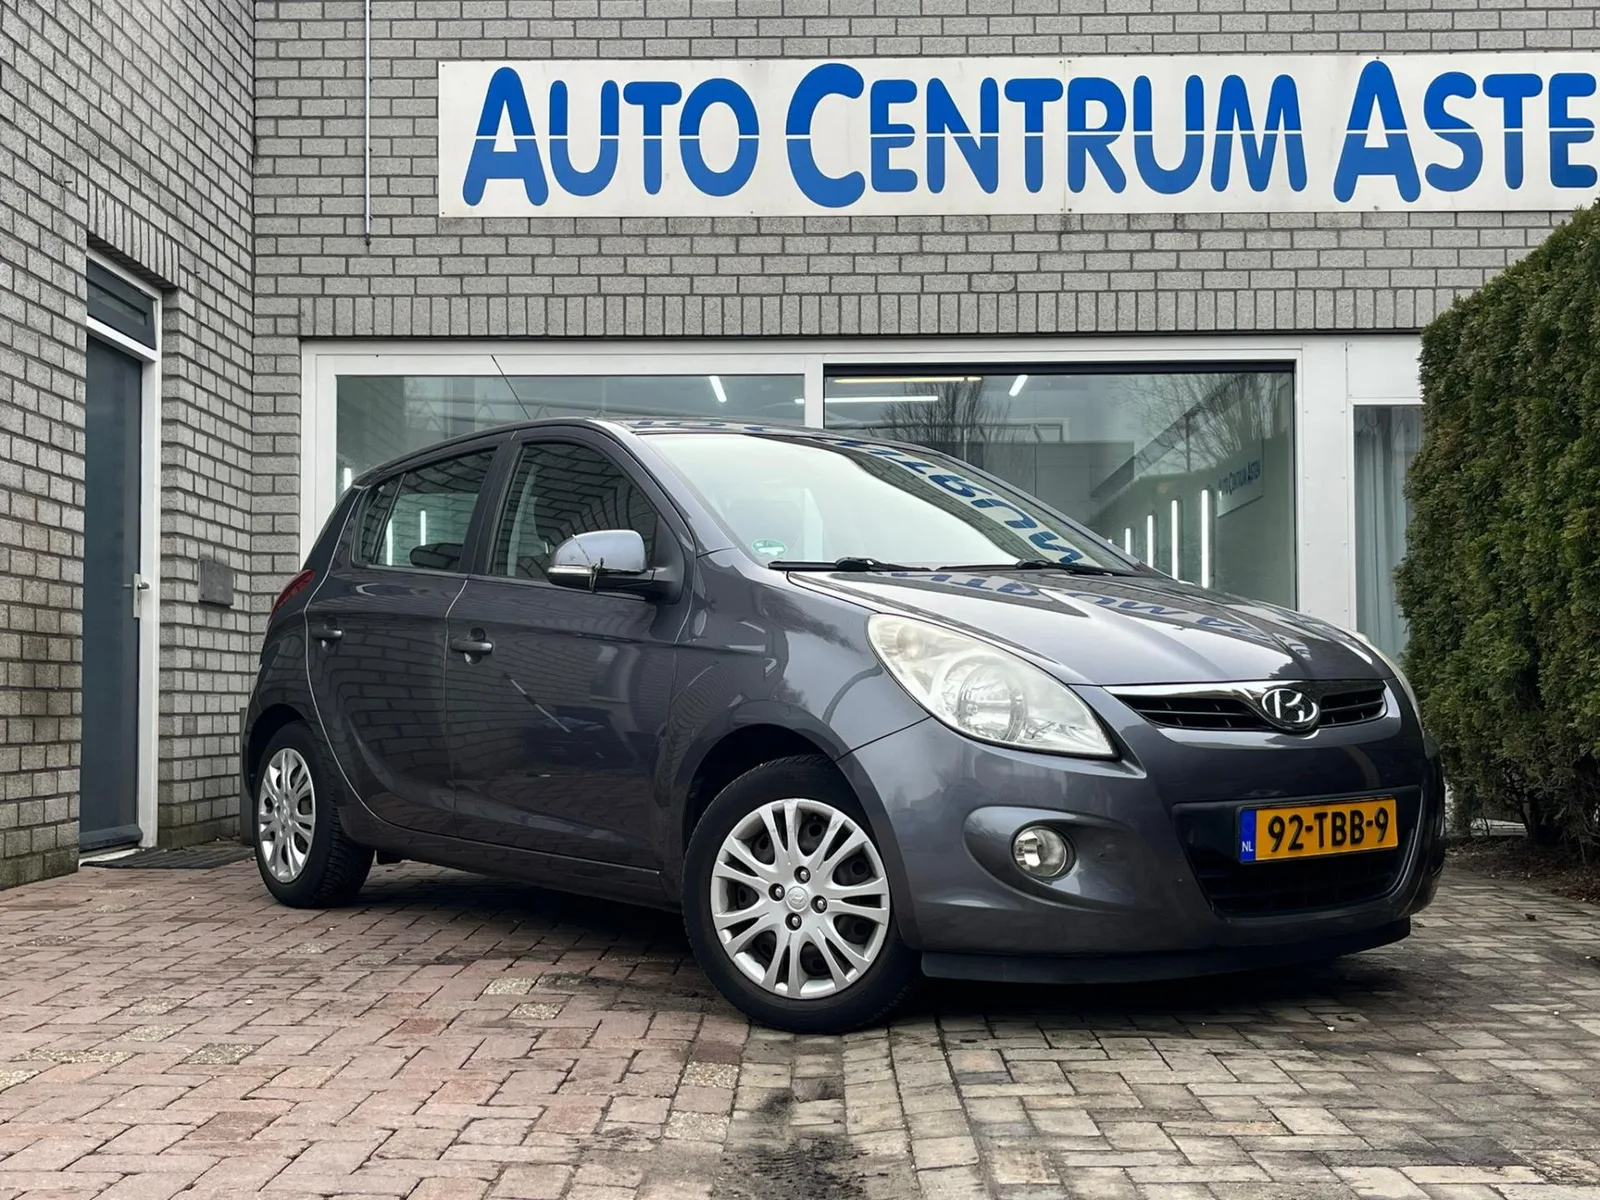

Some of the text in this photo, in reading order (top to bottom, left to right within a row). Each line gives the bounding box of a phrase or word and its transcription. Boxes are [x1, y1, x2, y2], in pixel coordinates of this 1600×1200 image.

[463, 67, 759, 206] AUTO
[785, 63, 1307, 208] CENTRUM
[1241, 840, 1254, 852] NL
[1267, 807, 1389, 853] 92-TBB-9
